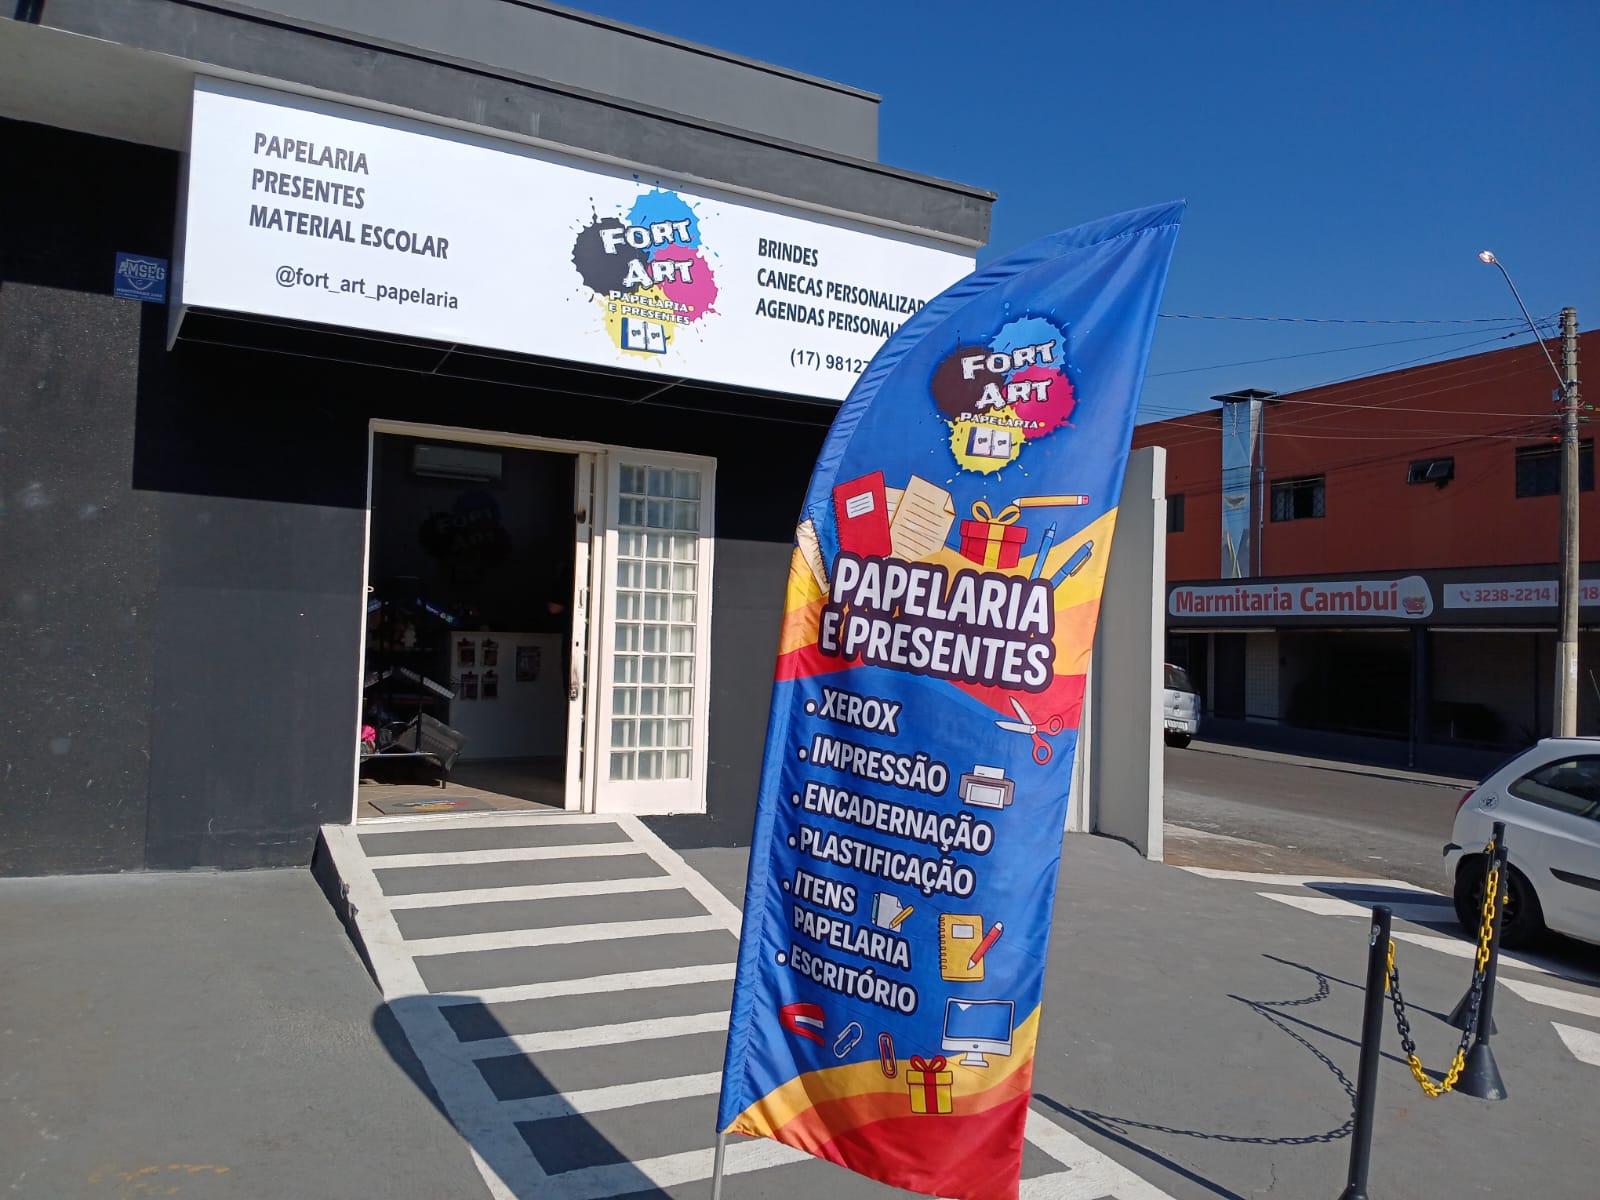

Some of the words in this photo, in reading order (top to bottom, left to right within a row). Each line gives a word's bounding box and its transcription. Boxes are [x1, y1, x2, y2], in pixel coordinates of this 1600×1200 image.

[253, 131, 369, 175] PAPELARIA
[251, 168, 365, 209] PRESENTES
[248, 204, 356, 243] MATERIAL
[360, 223, 449, 260] ESCOLAR
[600, 217, 691, 255] FORT
[757, 237, 819, 268] BRINDES
[275, 265, 459, 310] @fort_art_papelaria
[622, 258, 694, 289] ART
[756, 267, 824, 298] CANECAS
[608, 289, 689, 313] PAPELARIA
[608, 302, 617, 312] E
[621, 304, 691, 326] PRESENTES
[755, 297, 825, 328] AGENDAS
[828, 310, 901, 338] PERSONAL
[790, 348, 821, 371] (17)
[960, 339, 1056, 380] FORT
[974, 378, 1053, 410] ART
[960, 411, 1038, 429] PAPELARIA
[833, 557, 1050, 635] PAPELARIA
[1175, 585, 1293, 613] Marmitaria
[1299, 580, 1399, 612] Cambuí
[1474, 587, 1551, 602] 3238-2214
[822, 611, 840, 651] E
[845, 616, 1050, 687] PRESENTES
[820, 688, 900, 733] XEROX
[812, 735, 947, 793] IMPRESSÃO
[804, 783, 993, 852] ENCADERNAÇÃO
[800, 827, 974, 896] PLASTIFICAÇÃO
[793, 870, 856, 913] ITENS
[793, 905, 910, 969] PAPELARIA
[791, 944, 917, 1012] ESCRITÓRIO
